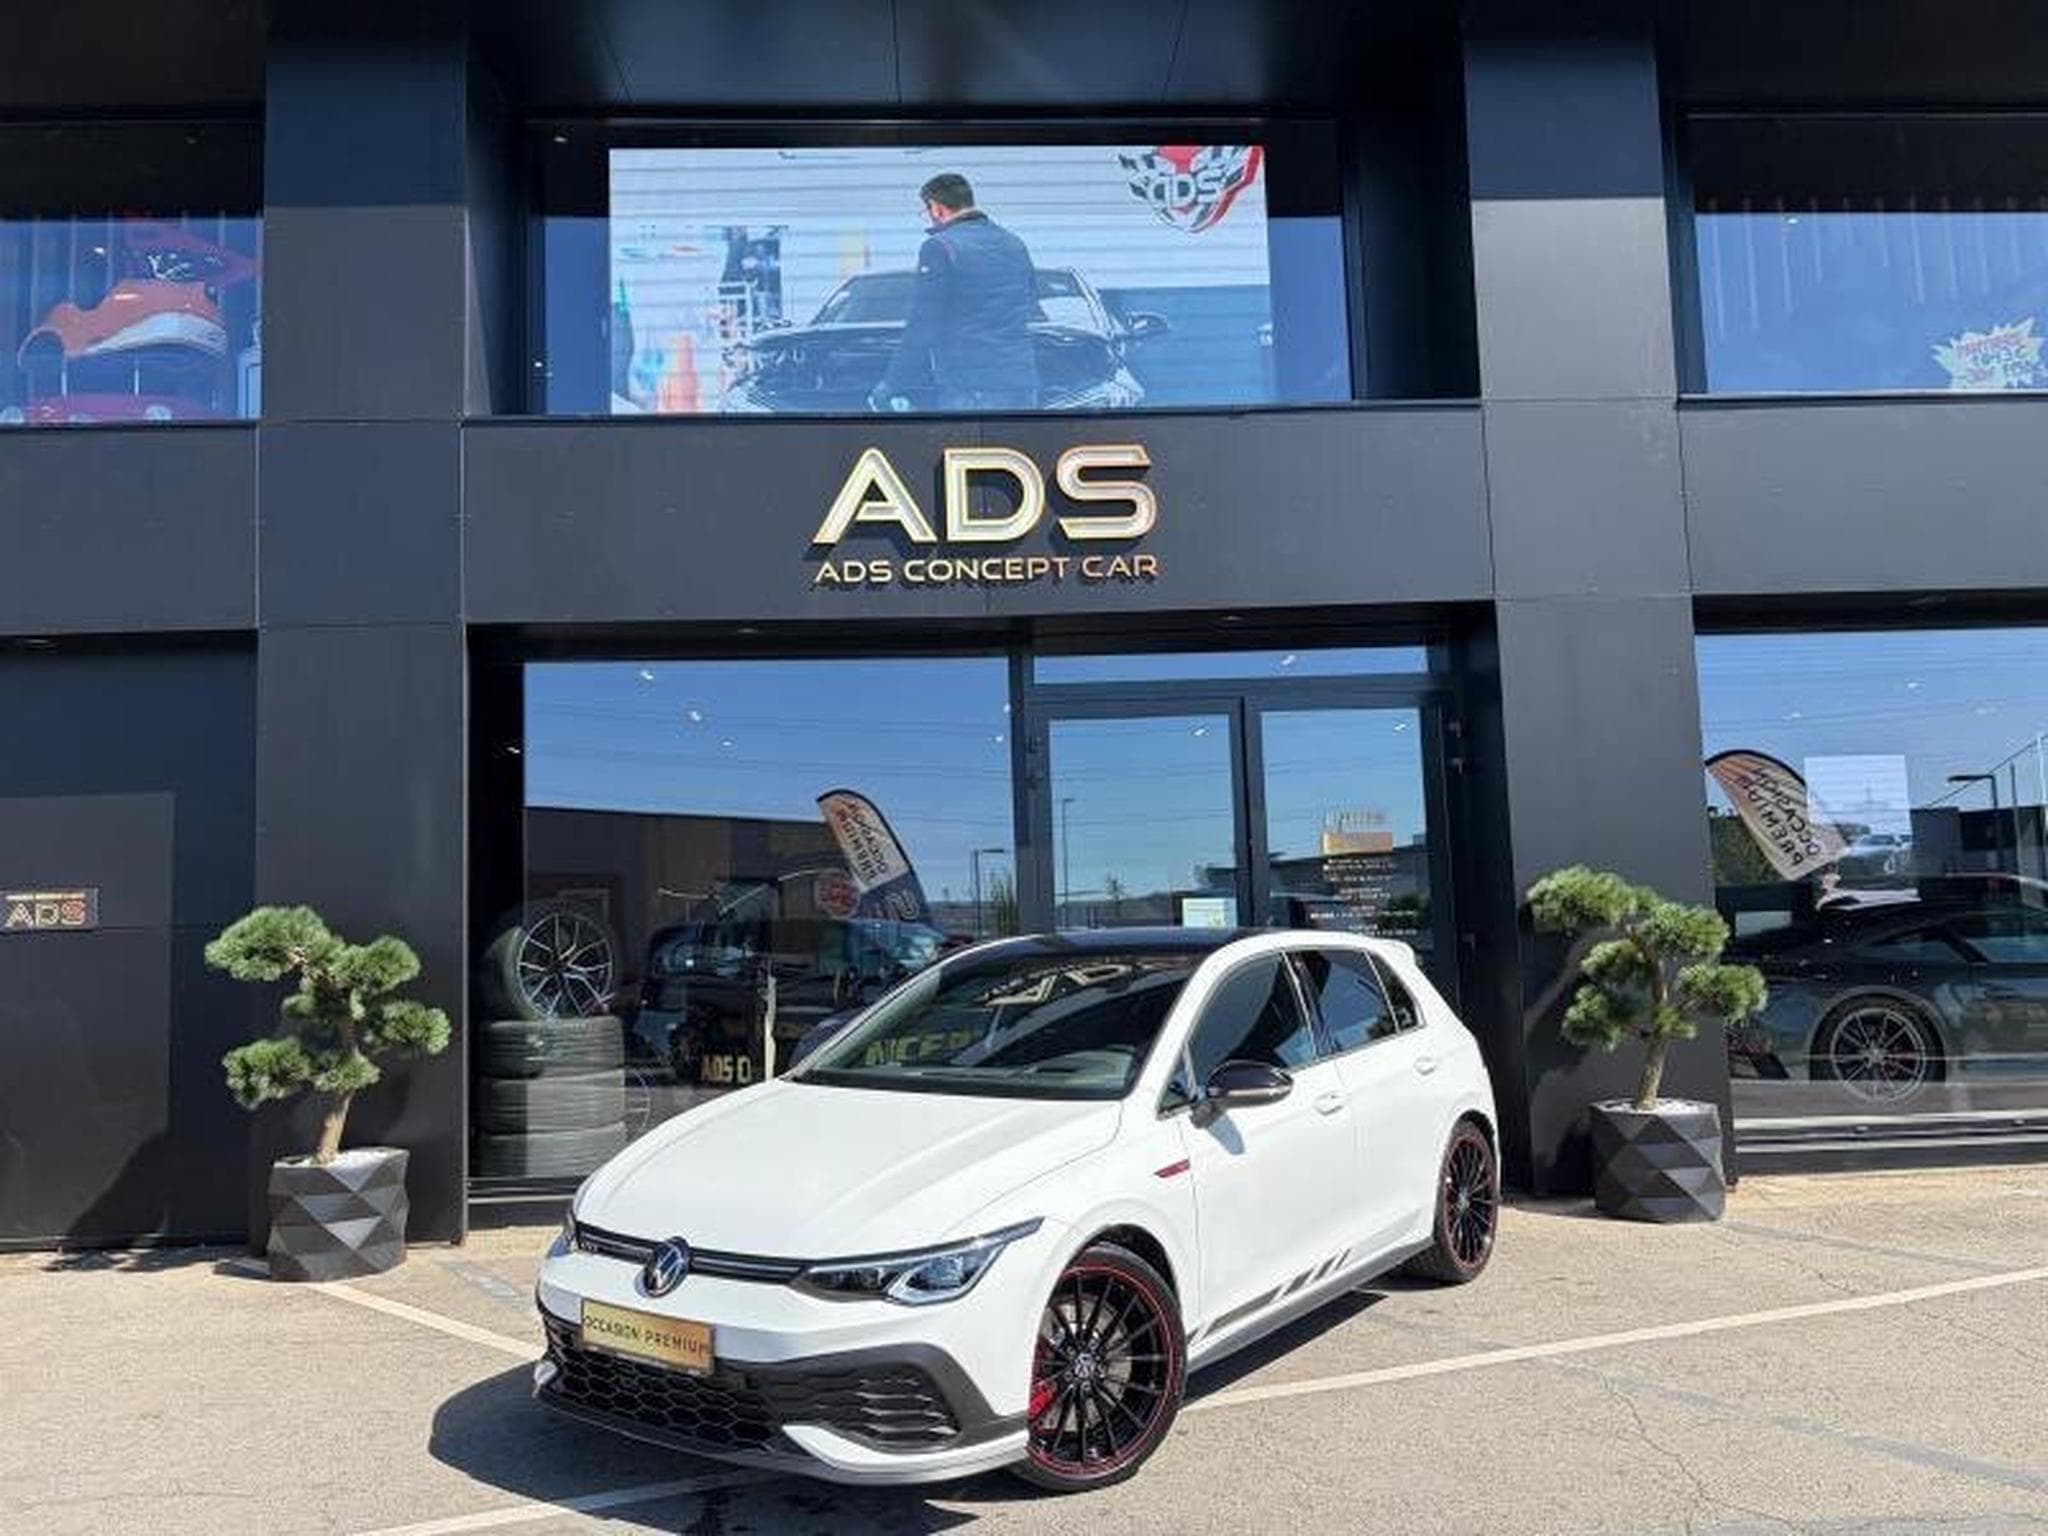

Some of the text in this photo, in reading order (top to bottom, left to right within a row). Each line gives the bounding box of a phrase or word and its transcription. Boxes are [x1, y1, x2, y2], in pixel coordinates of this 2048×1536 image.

[812, 445, 1157, 543] ADS
[814, 554, 1160, 583] ADS CONCEPT CAR
[4, 900, 86, 928] ADS
